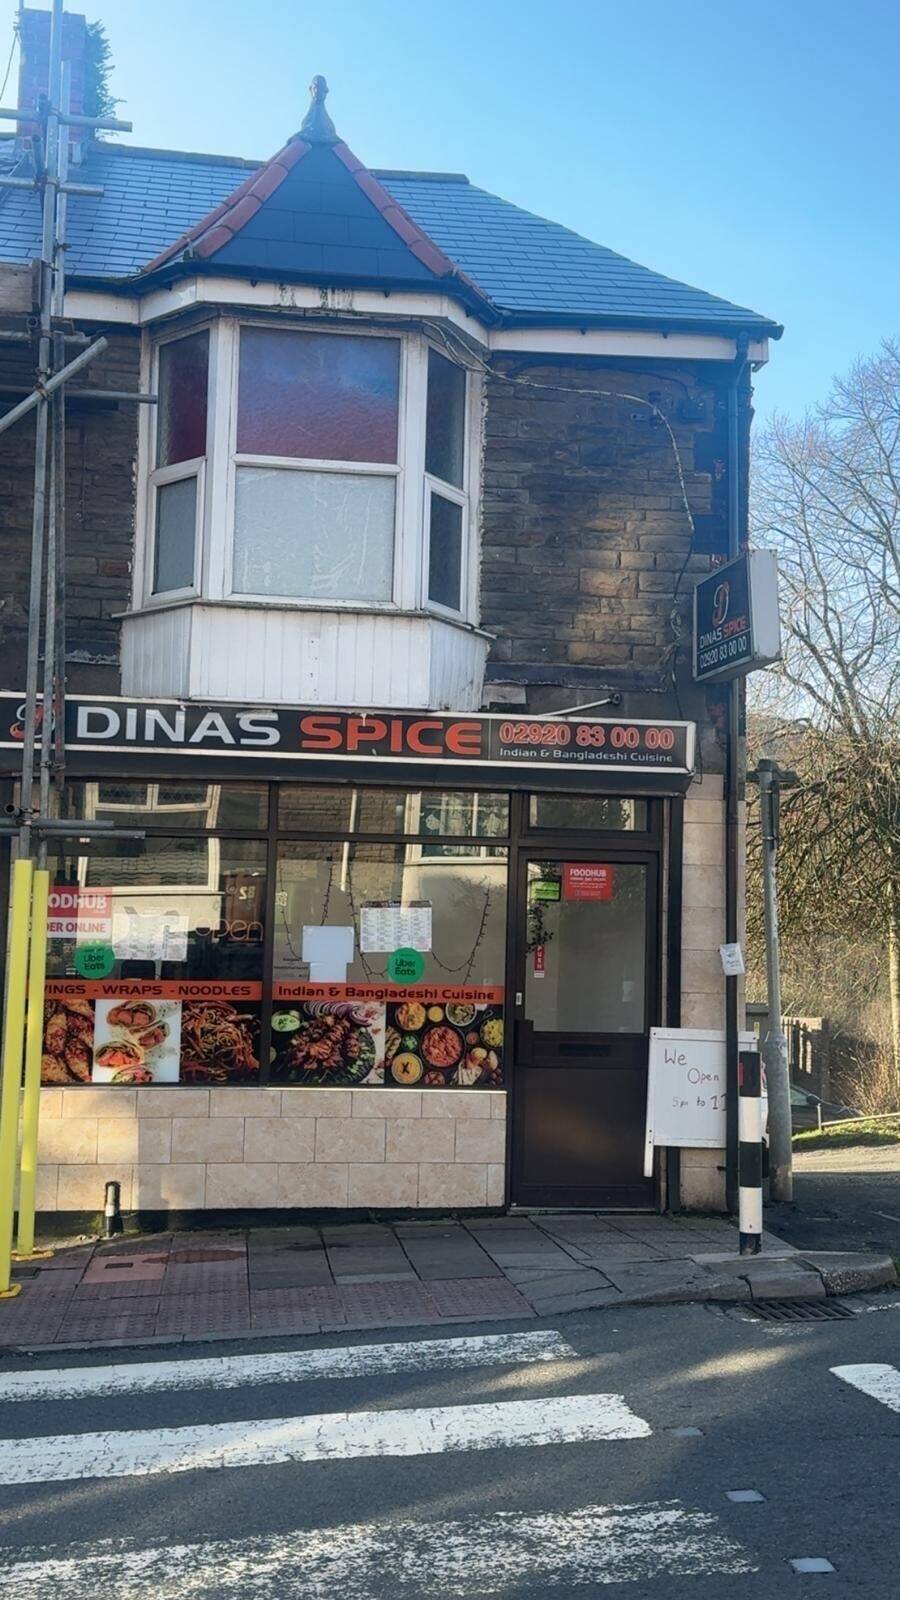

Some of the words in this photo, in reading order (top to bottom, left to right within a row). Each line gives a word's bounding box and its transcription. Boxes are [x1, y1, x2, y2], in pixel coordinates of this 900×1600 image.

[700, 627, 722, 649] DINAS
[723, 616, 746, 638] SPICE
[719, 644, 728, 661] 83
[728, 640, 738, 657] 00
[738, 635, 747, 652] 00
[77, 706, 281, 745] DINAS
[299, 716, 482, 755] SPICE
[499, 721, 571, 746] 02920
[576, 725, 605, 747] 83
[610, 726, 640, 749] 00
[645, 728, 674, 750] 00
[500, 748, 537, 758] Indian
[540, 749, 550, 758] &
[553, 749, 628, 761] Bangladeshi
[630, 752, 673, 763] Cuisine
[570, 868, 607, 877] FOODHUB
[47, 922, 63, 933] ER
[66, 922, 106, 933] ONLINE
[195, 918, 264, 946] open
[84, 954, 105, 962] Uber
[395, 958, 415, 968] Uber
[84, 963, 105, 971] Eats
[395, 967, 416, 976] Eats
[102, 985, 163, 995] WRAPS
[178, 985, 250, 996] NOODLES
[278, 986, 324, 997] Indian
[329, 987, 340, 997] &
[345, 987, 437, 999] Bangladeshi
[442, 989, 494, 1000] Cuisine
[664, 1048, 687, 1065] We
[688, 1067, 719, 1084] Open
[696, 1096, 706, 1107] to
